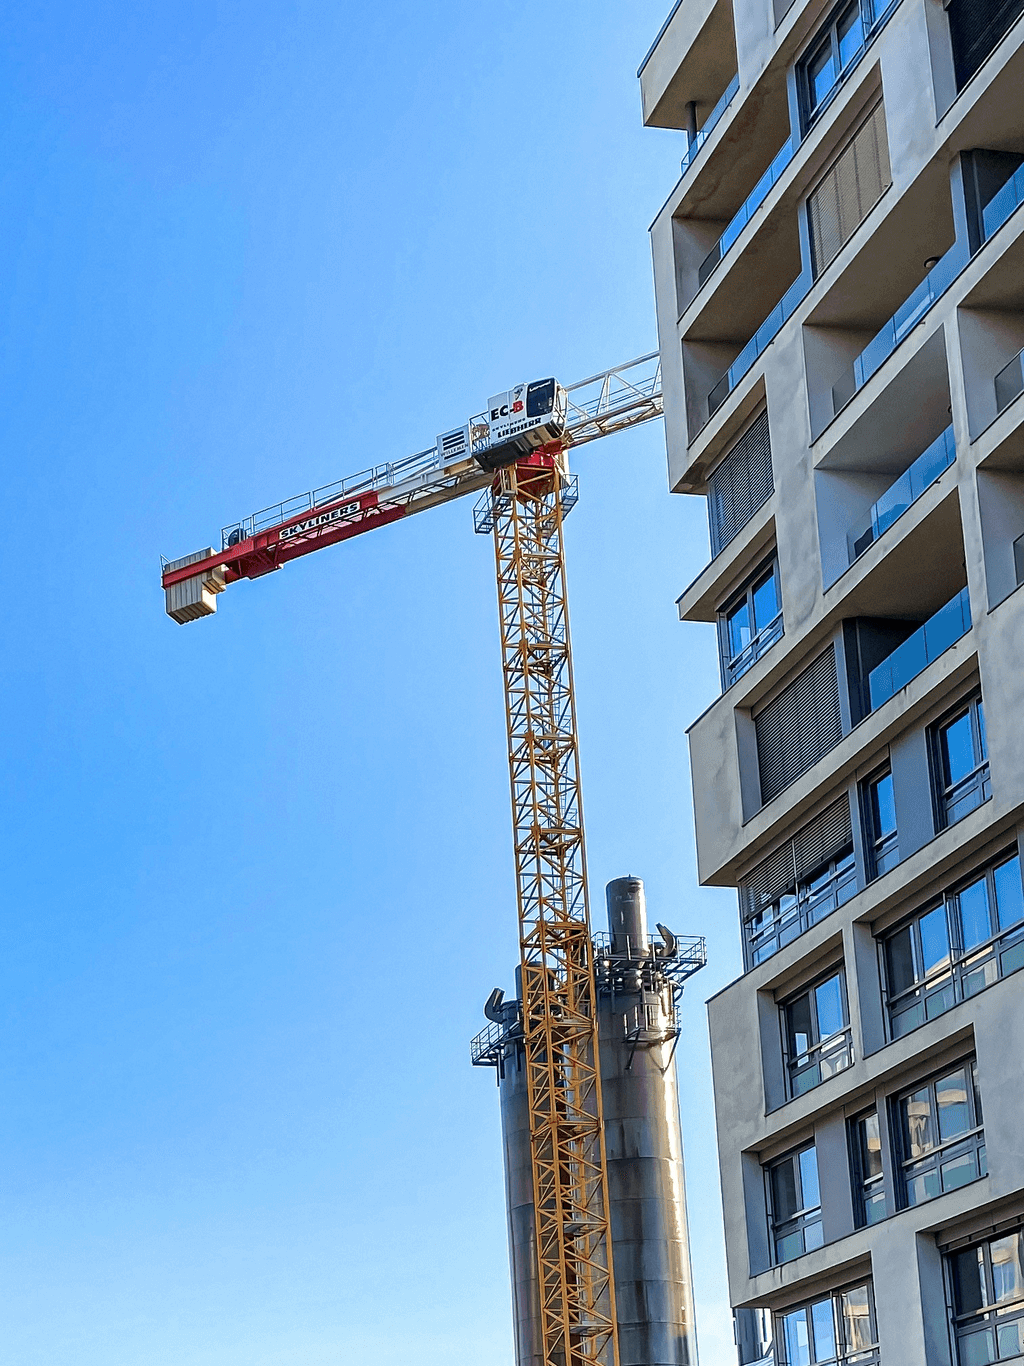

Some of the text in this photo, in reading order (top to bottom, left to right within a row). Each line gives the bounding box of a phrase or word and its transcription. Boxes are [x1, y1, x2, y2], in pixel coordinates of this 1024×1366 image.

[491, 401, 524, 421] EC-B
[498, 417, 542, 438] LIEBHERR
[280, 503, 359, 539] SKYLINERS
